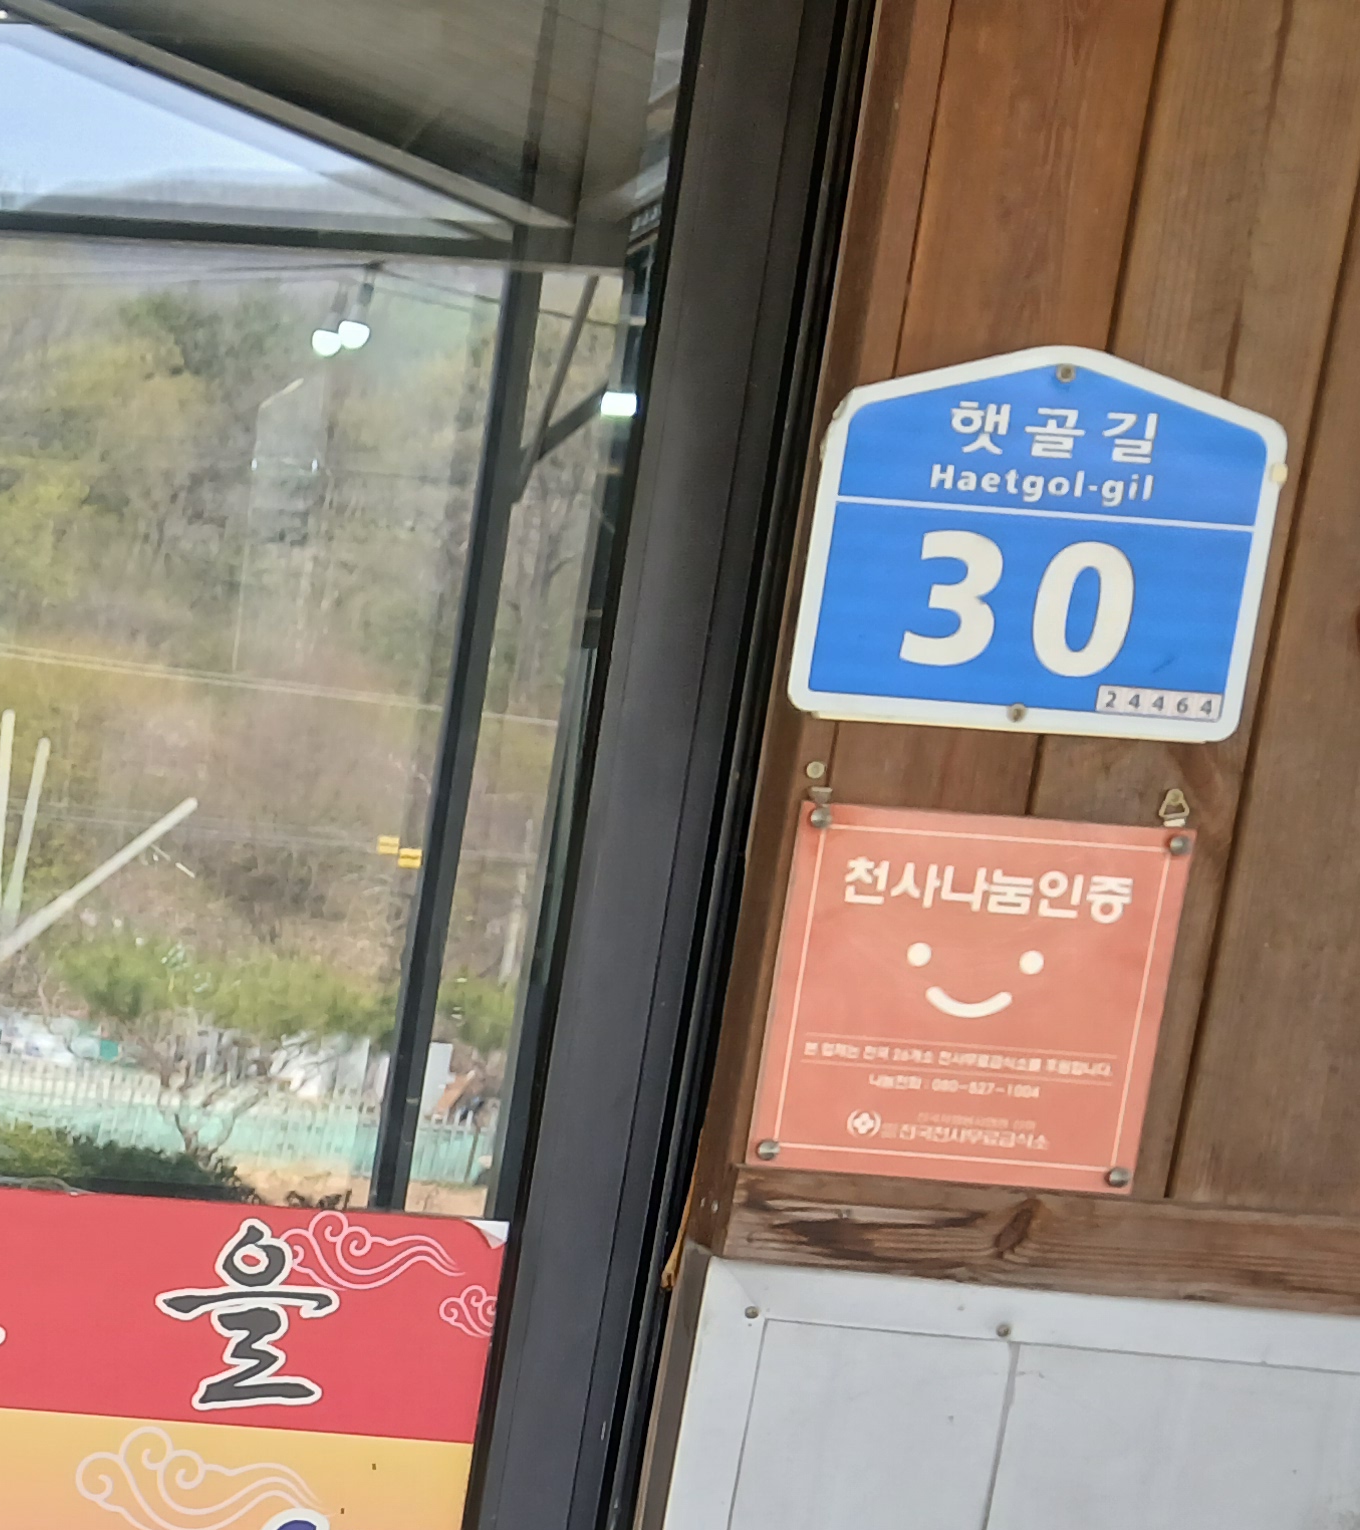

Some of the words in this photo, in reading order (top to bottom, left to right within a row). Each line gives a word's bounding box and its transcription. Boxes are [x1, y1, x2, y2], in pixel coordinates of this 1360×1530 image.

[950, 401, 1159, 464] 햇골길
[930, 464, 1155, 507] Haetgol-gil
[899, 529, 1135, 678] 30
[1104, 690, 1213, 716] 24464
[844, 856, 1133, 924] 천사나눔인증
